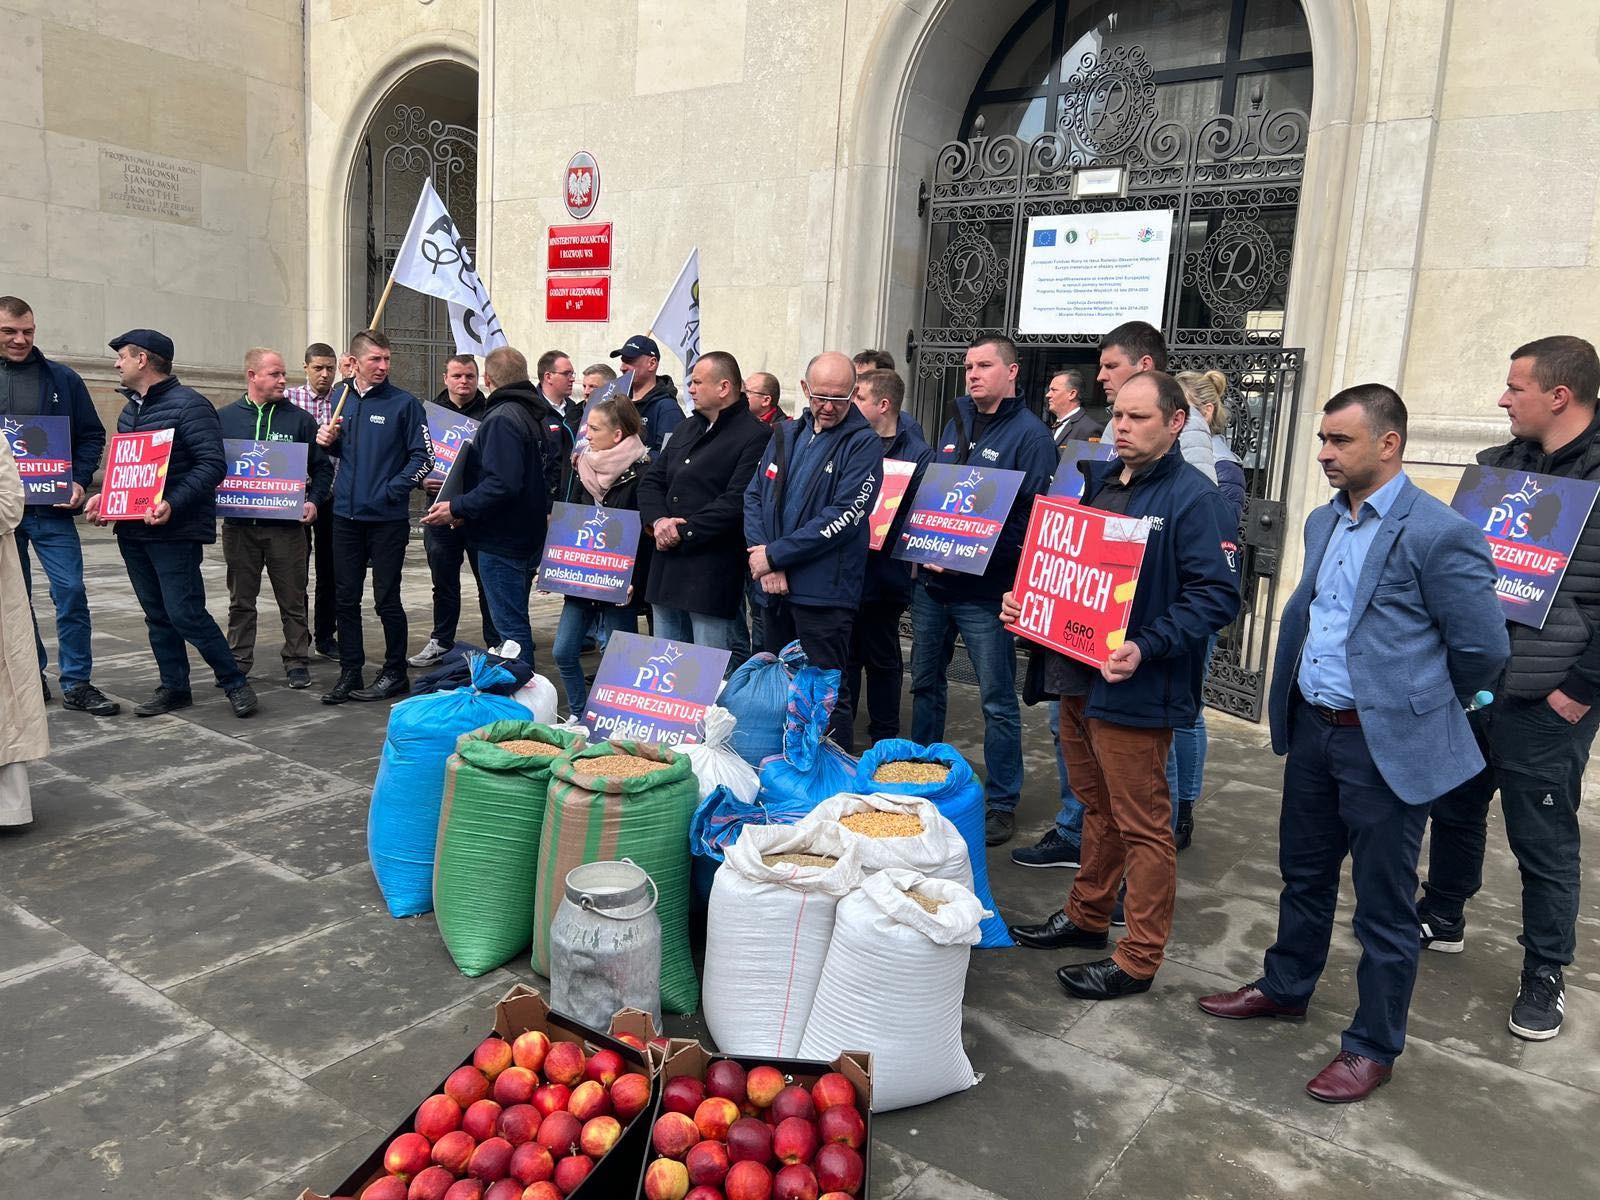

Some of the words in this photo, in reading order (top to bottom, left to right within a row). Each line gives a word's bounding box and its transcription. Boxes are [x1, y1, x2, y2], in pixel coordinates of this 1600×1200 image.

[550, 236, 579, 246] MINISTERSTWO
[580, 235, 608, 244] ROLNICTWA
[563, 249, 584, 259] ROZWOJU
[585, 249, 593, 258] WSI
[550, 288, 568, 297] GODZINY
[115, 439, 145, 463] KRAJ
[111, 463, 158, 489] CHORYCH
[234, 458, 271, 476] PiS
[30, 480, 55, 493] wsi
[223, 479, 300, 491] REPREZENTUJE
[107, 491, 129, 514] CEN
[252, 496, 298, 507] rolników
[941, 489, 976, 513] PiS
[910, 513, 923, 524] NIE
[924, 515, 996, 537] REPREZENTUJE
[1483, 503, 1532, 538] PiS
[575, 527, 606, 549] PiS
[1037, 509, 1088, 558] KRAJ
[907, 535, 954, 555] polskiej
[955, 544, 979, 558] wsi
[1489, 543, 1560, 573] EZENTUJE
[548, 548, 563, 560] NIE
[564, 551, 630, 570] REPREZENTUJE
[545, 567, 583, 581] polskich
[585, 574, 625, 588] rolników
[1028, 551, 1113, 613] CHORYCH
[1495, 575, 1545, 602] lników
[1019, 591, 1055, 637] CEN
[1064, 619, 1094, 639] AGRO
[633, 664, 678, 693] PiS
[596, 688, 615, 702] NIE
[617, 692, 704, 722] REPREZENTUJE
[594, 715, 655, 743] polskiej
[657, 731, 685, 746] wsi
